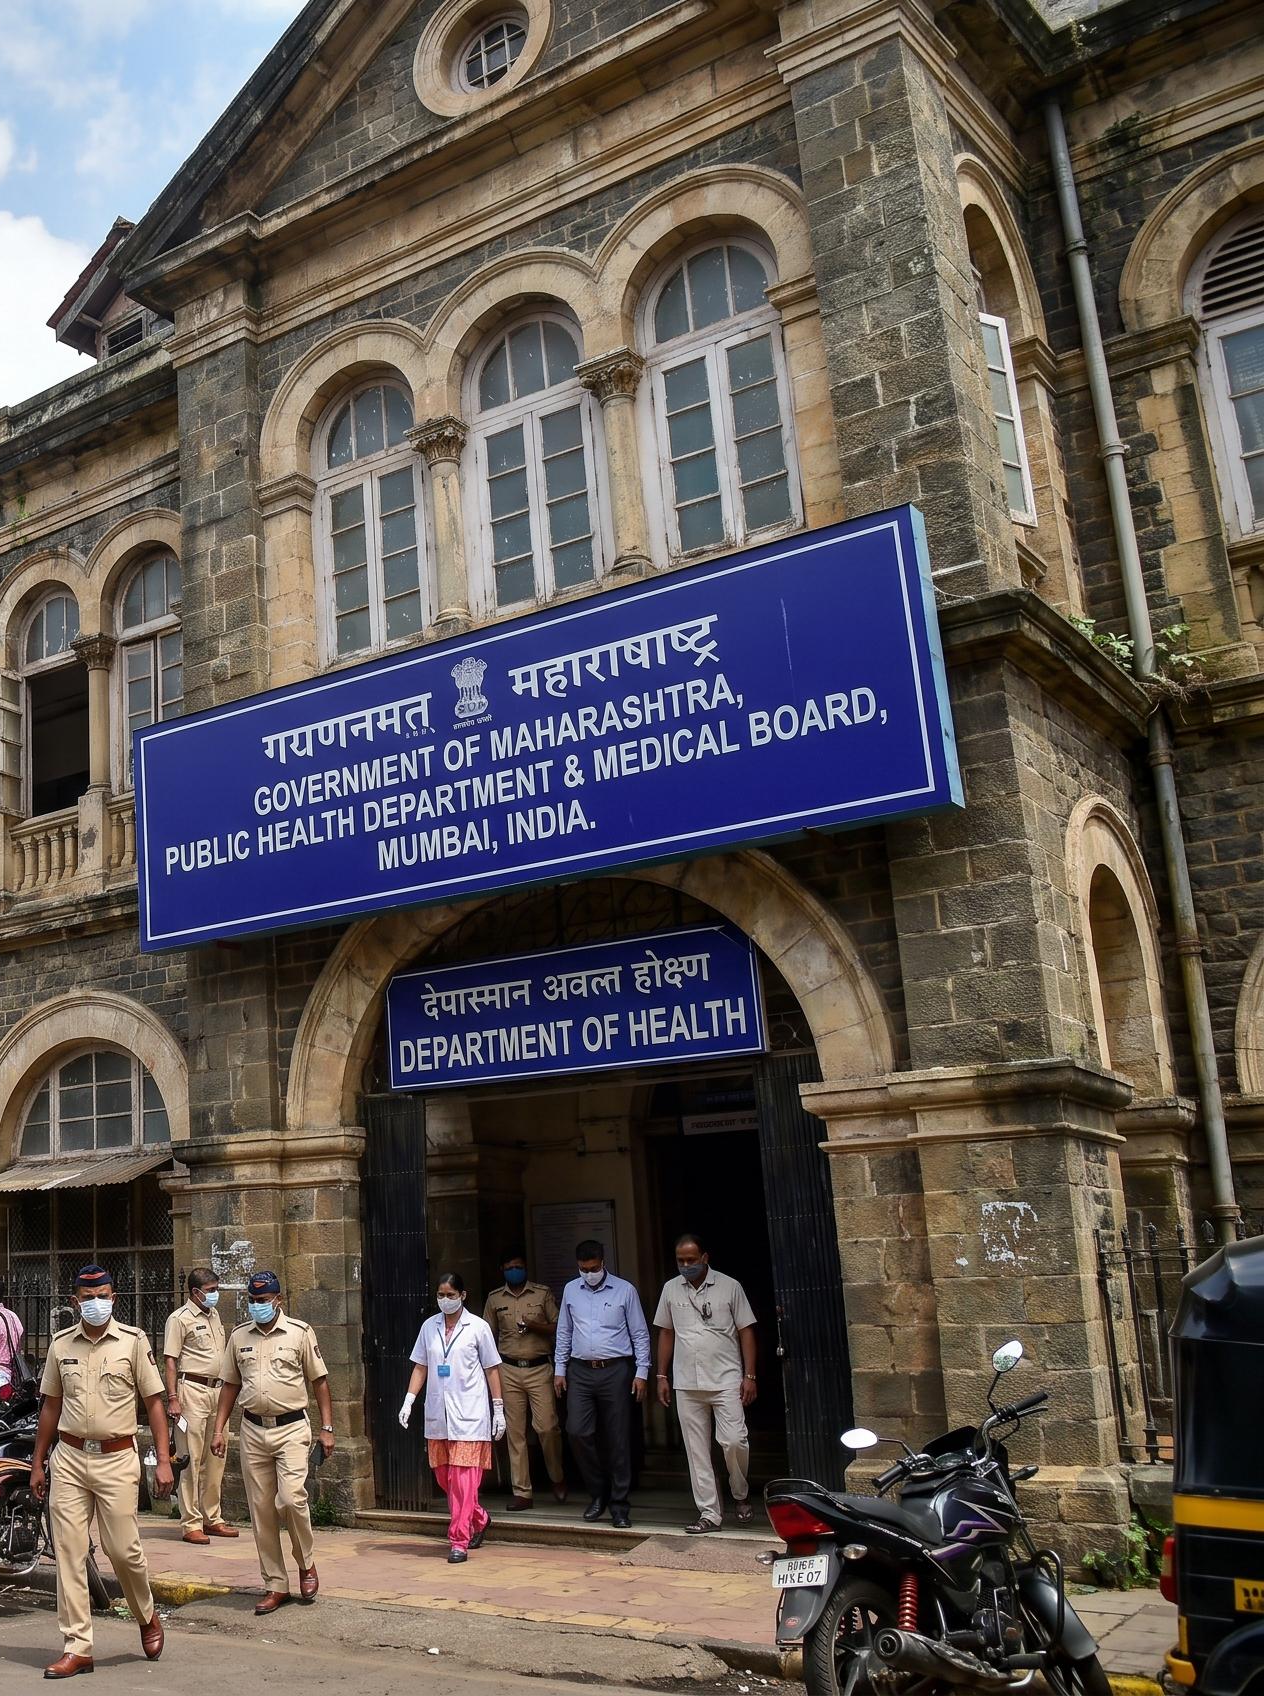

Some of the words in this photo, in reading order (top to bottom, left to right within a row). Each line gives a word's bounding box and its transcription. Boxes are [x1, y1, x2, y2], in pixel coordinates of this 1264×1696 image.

[165, 830, 250, 876] PUBLIC
[257, 805, 355, 856] HEALTH
[363, 759, 554, 833] DEPARTMENT
[563, 754, 585, 788] &
[593, 720, 740, 782] MEDICAL
[748, 687, 888, 747] BOARD,
[254, 745, 435, 816] GOVERNMENT
[443, 735, 481, 772] OF
[490, 673, 743, 762] MAHARASHTRA,
[377, 818, 499, 871] MUMBAI,
[506, 799, 596, 845] INDIA.
[399, 1019, 574, 1073] DEPARTMENT
[582, 1013, 619, 1052] OF
[628, 996, 747, 1047] HEALTH
